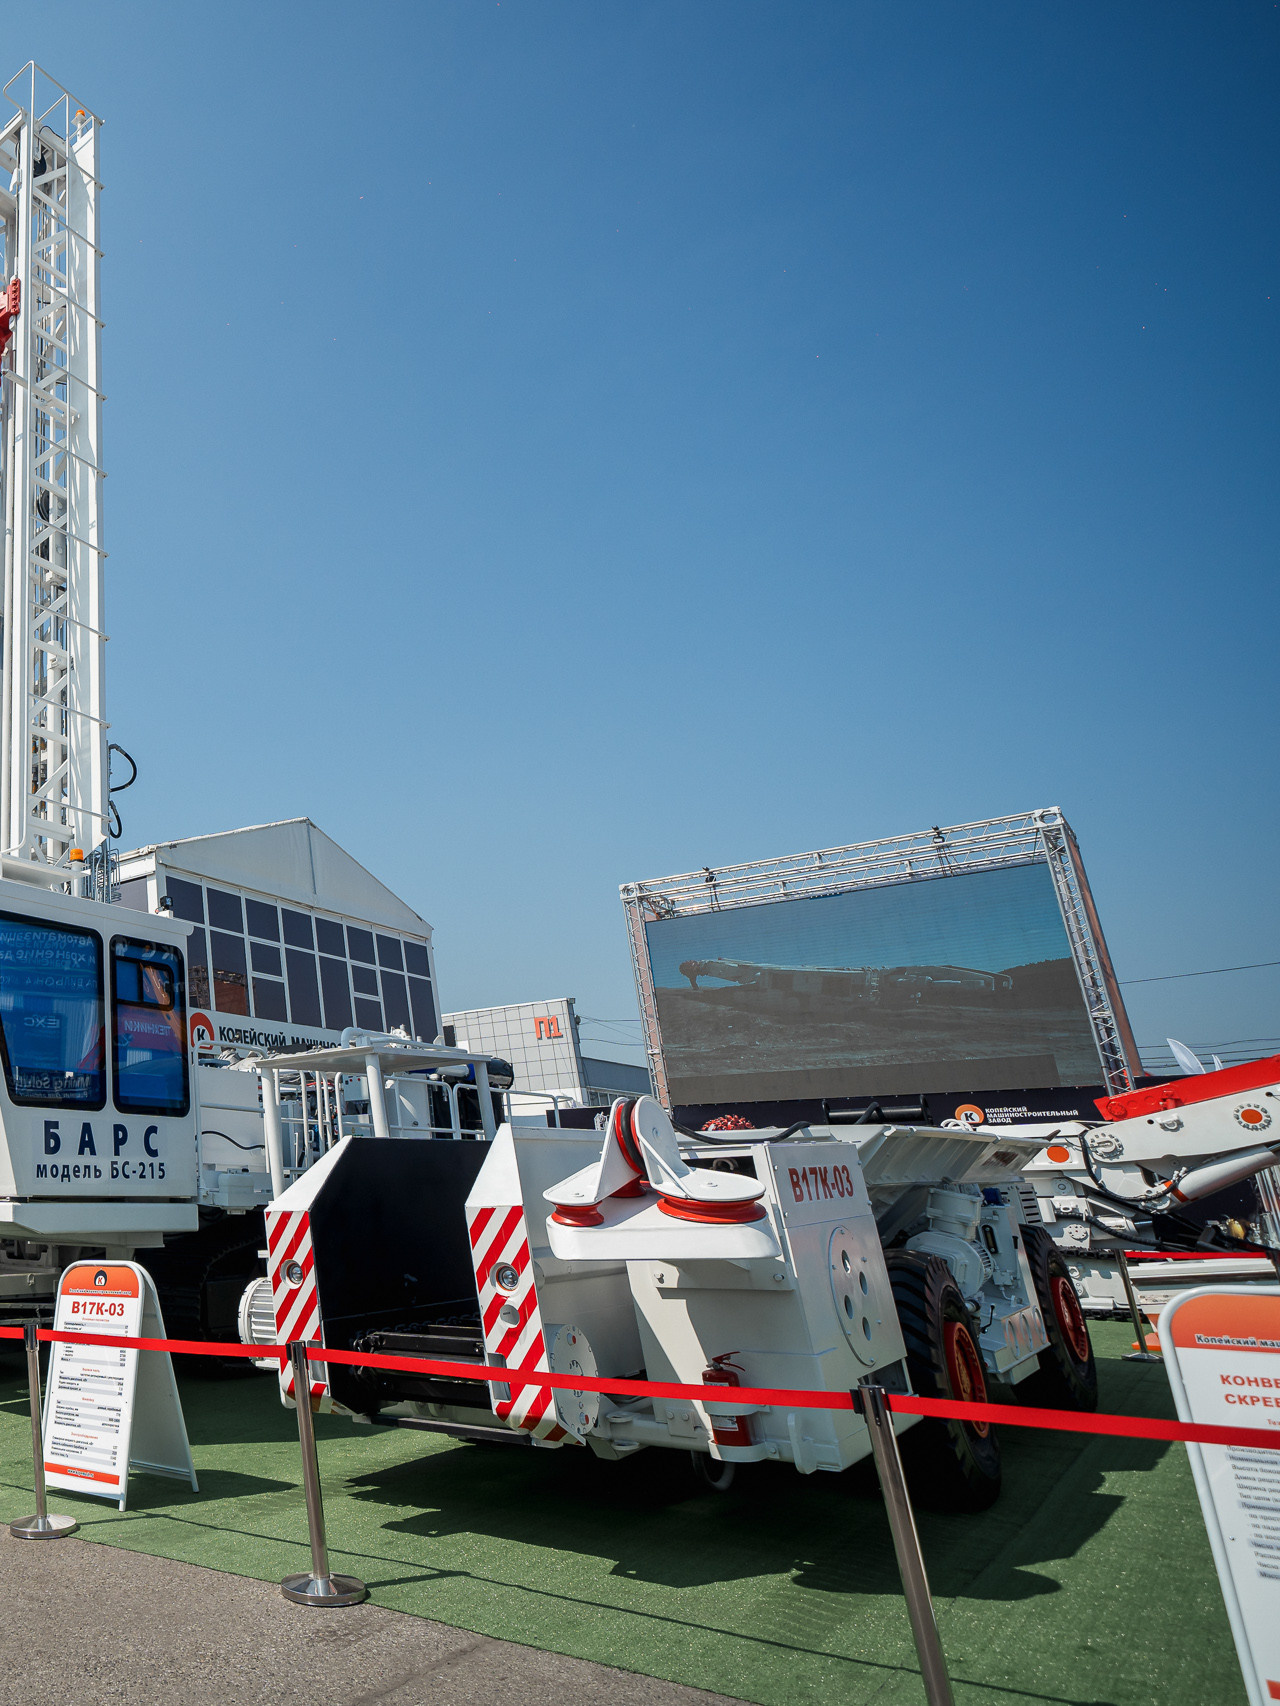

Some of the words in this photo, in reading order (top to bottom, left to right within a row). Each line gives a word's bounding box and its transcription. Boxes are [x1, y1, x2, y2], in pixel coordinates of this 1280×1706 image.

[219, 1026, 286, 1047] КОПЕЙСКИЙ
[534, 1015, 563, 1039] П1
[985, 1106, 1028, 1114] КОПЕЙСКИЙ
[986, 1109, 1079, 1118] МАШИНОСТРОИТЕЛЬНЫЙ
[44, 1120, 159, 1158] БАРС
[36, 1164, 102, 1182] модель
[110, 1161, 166, 1179] БС-215
[788, 1165, 853, 1202] В17К-03
[71, 1301, 124, 1316] В17К-03
[1195, 1334, 1257, 1346] Копейский
